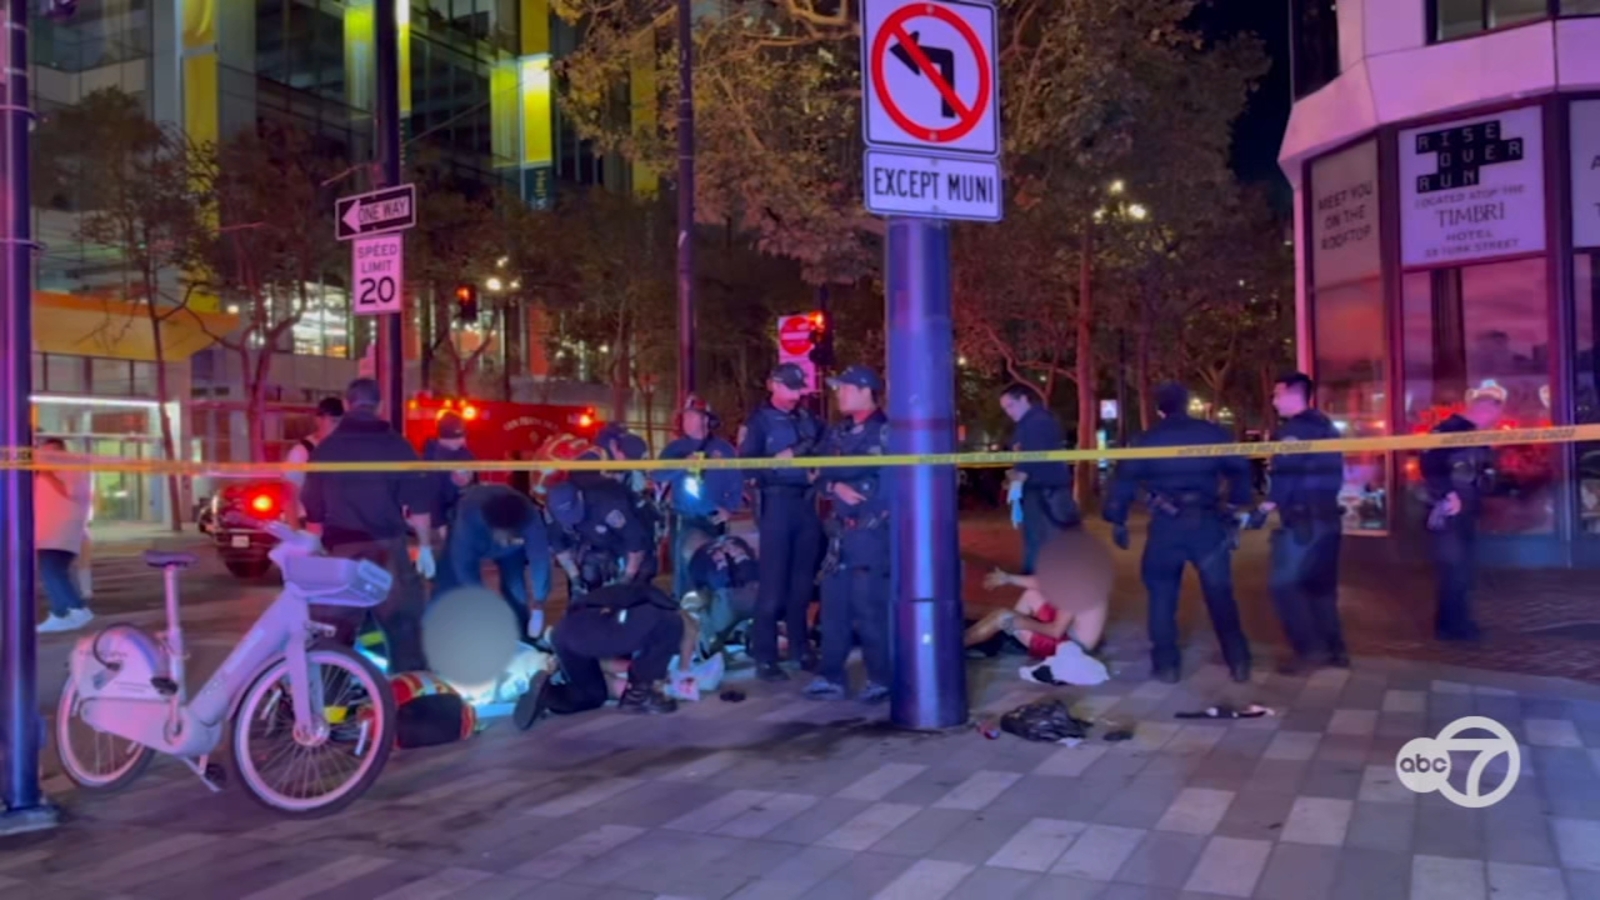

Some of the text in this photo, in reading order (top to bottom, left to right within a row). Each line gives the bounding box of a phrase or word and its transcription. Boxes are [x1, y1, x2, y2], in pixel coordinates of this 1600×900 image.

[1418, 123, 1496, 150] RISE
[873, 166, 993, 204] EXCEPT MUNI
[1420, 169, 1475, 191] RUN
[1319, 181, 1373, 211] MEET YOU
[358, 199, 407, 223] ONE WAY
[1325, 204, 1365, 231] ON THE
[1435, 201, 1505, 228] TIMBRI
[1321, 224, 1371, 250] ROOFTOP
[1445, 229, 1493, 242] HOTEL
[1475, 239, 1519, 251] STREET
[356, 243, 398, 259] SPEED
[361, 259, 393, 274] LIMIT
[359, 276, 396, 305] 20
